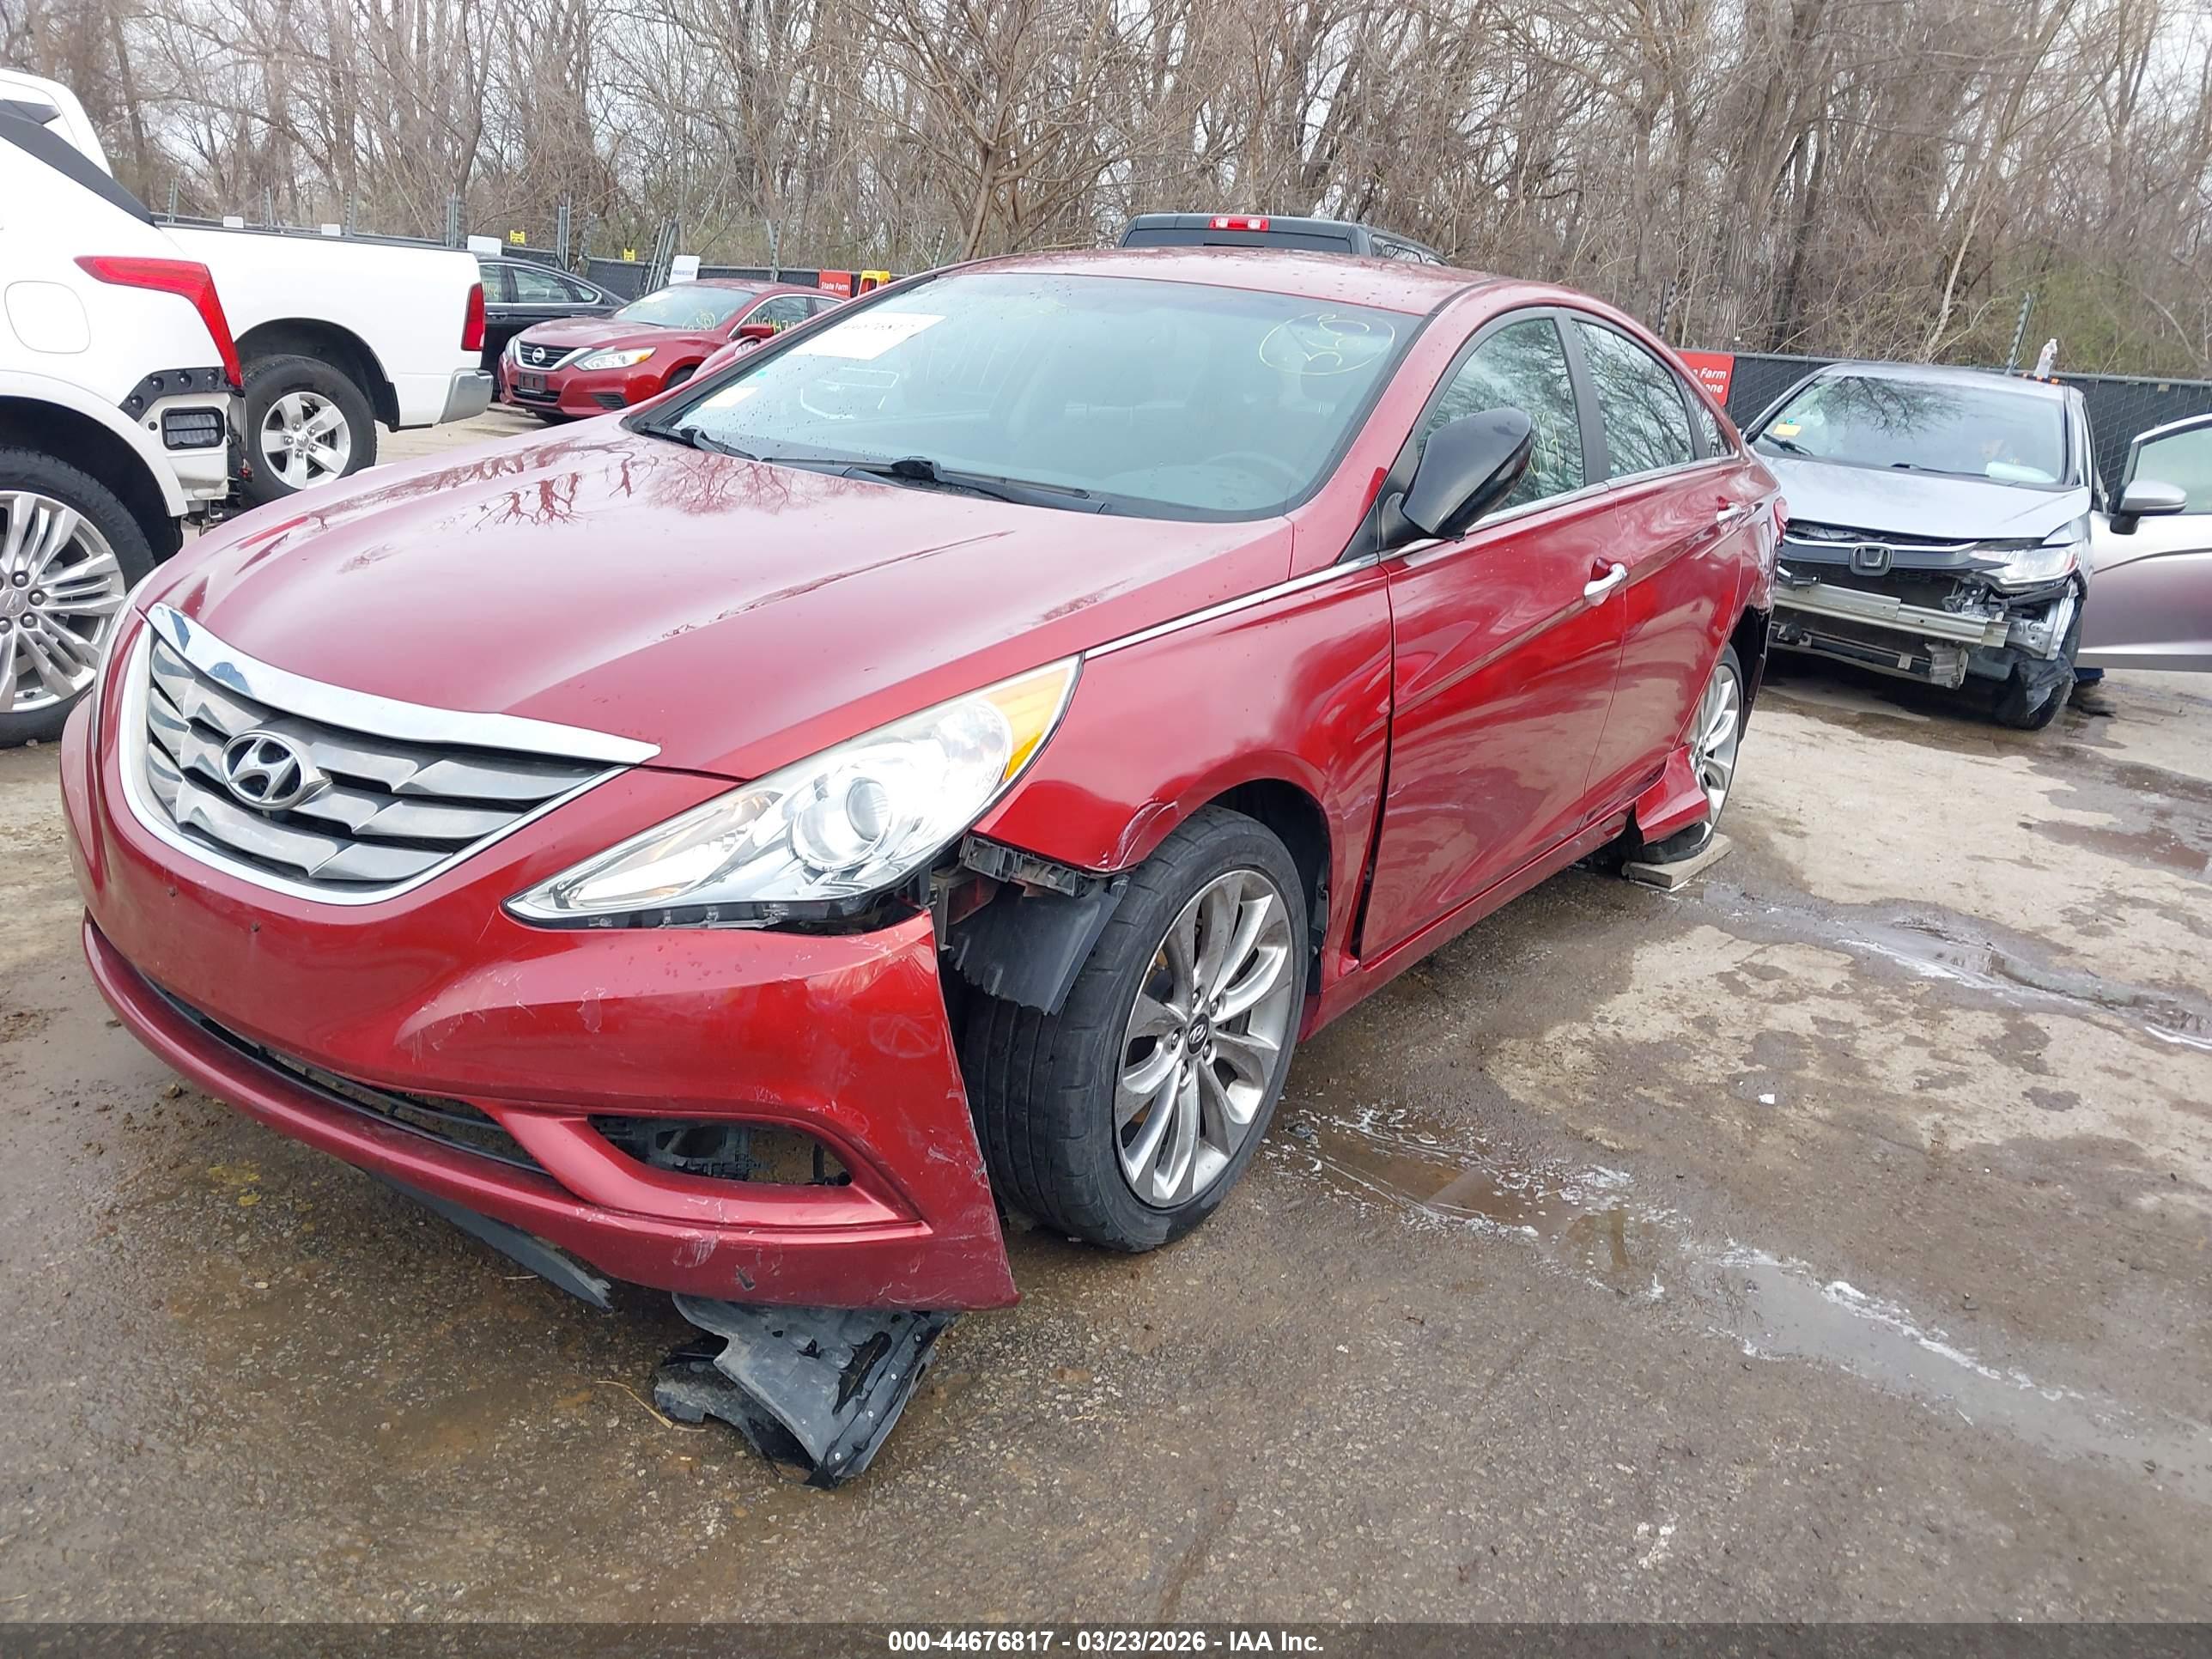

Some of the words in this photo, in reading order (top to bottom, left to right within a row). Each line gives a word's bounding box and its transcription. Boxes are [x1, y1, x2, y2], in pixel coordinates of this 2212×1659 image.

[821, 281, 835, 290] State
[836, 283, 849, 291] Farm
[1700, 368, 1727, 379] Farm
